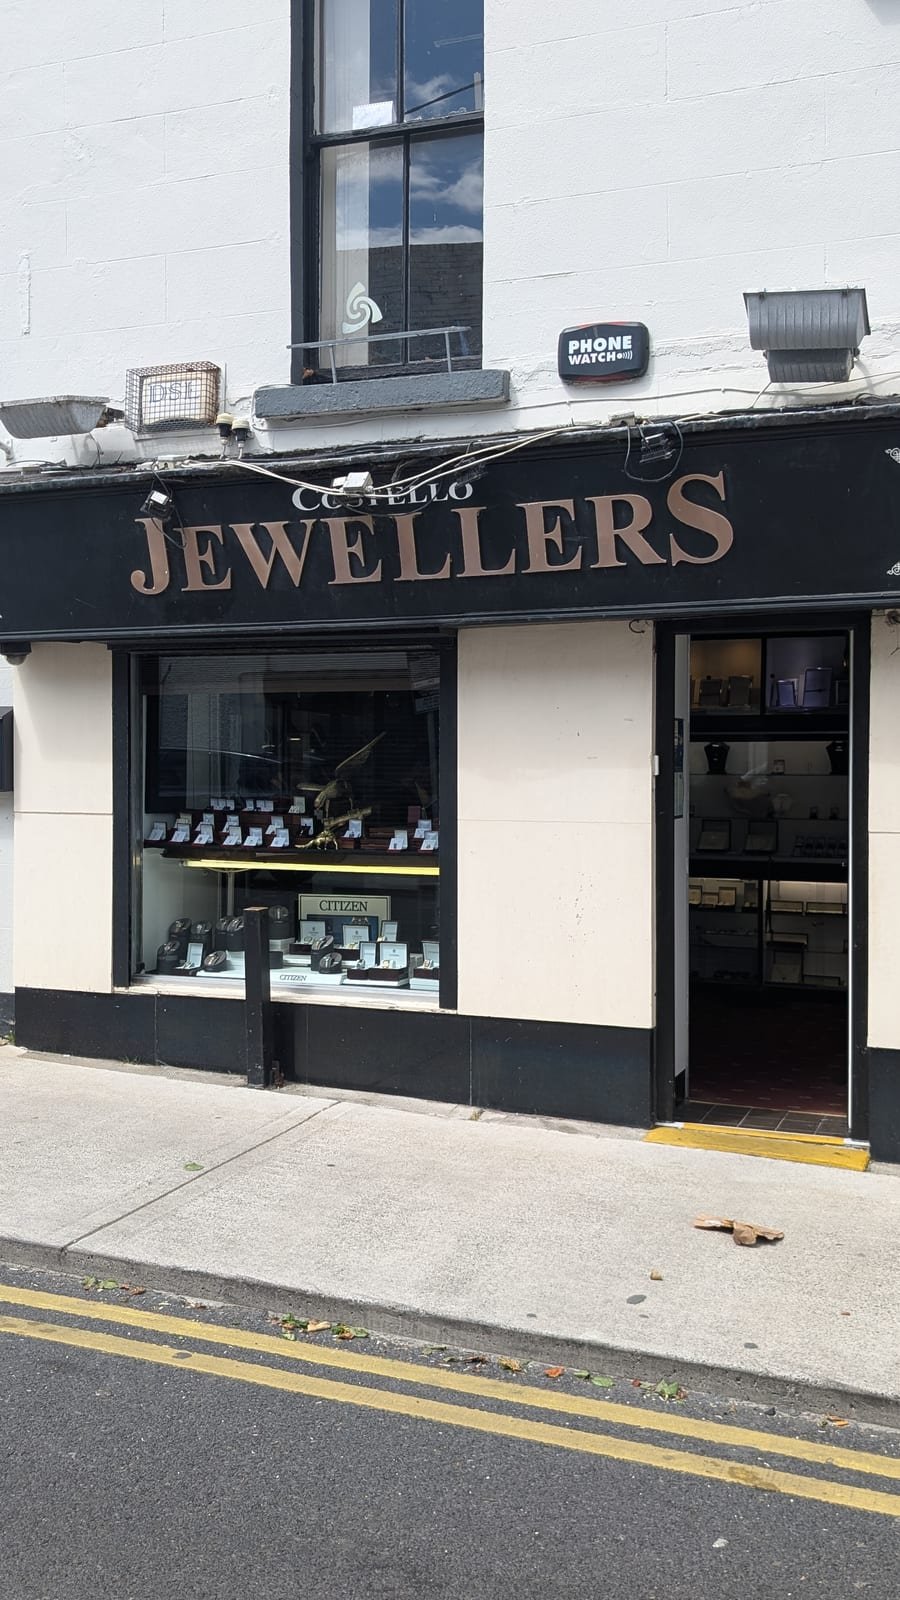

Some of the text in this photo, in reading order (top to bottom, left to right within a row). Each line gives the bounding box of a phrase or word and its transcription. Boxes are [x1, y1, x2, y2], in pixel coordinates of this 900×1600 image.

[568, 335, 632, 354] PHONE
[567, 351, 616, 365] WATCH
[130, 472, 735, 597] JEWELLERS
[319, 899, 369, 912] CITIZEN
[279, 974, 307, 982] CITIZEN
